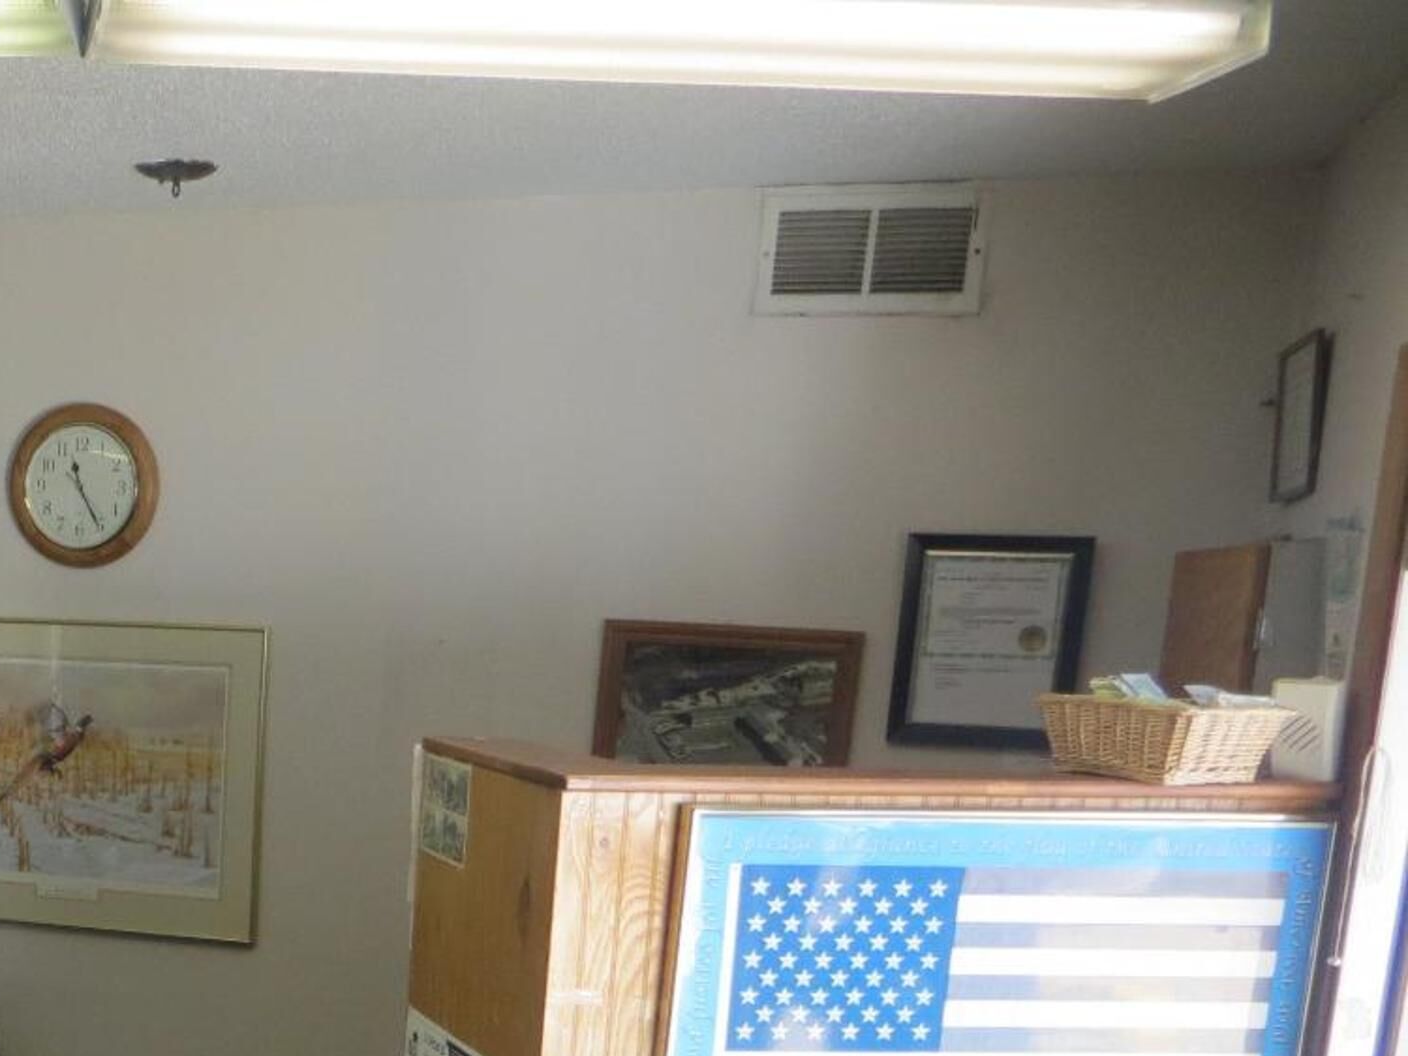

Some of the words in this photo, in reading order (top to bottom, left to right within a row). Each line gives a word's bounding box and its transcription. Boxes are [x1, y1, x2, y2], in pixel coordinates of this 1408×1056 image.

[56, 440, 68, 457] 11
[75, 436, 90, 452] 12
[42, 457, 56, 473] 10
[111, 457, 122, 473] 2
[36, 478, 47, 494] 9
[116, 480, 127, 496] 3
[41, 500, 52, 516] 8
